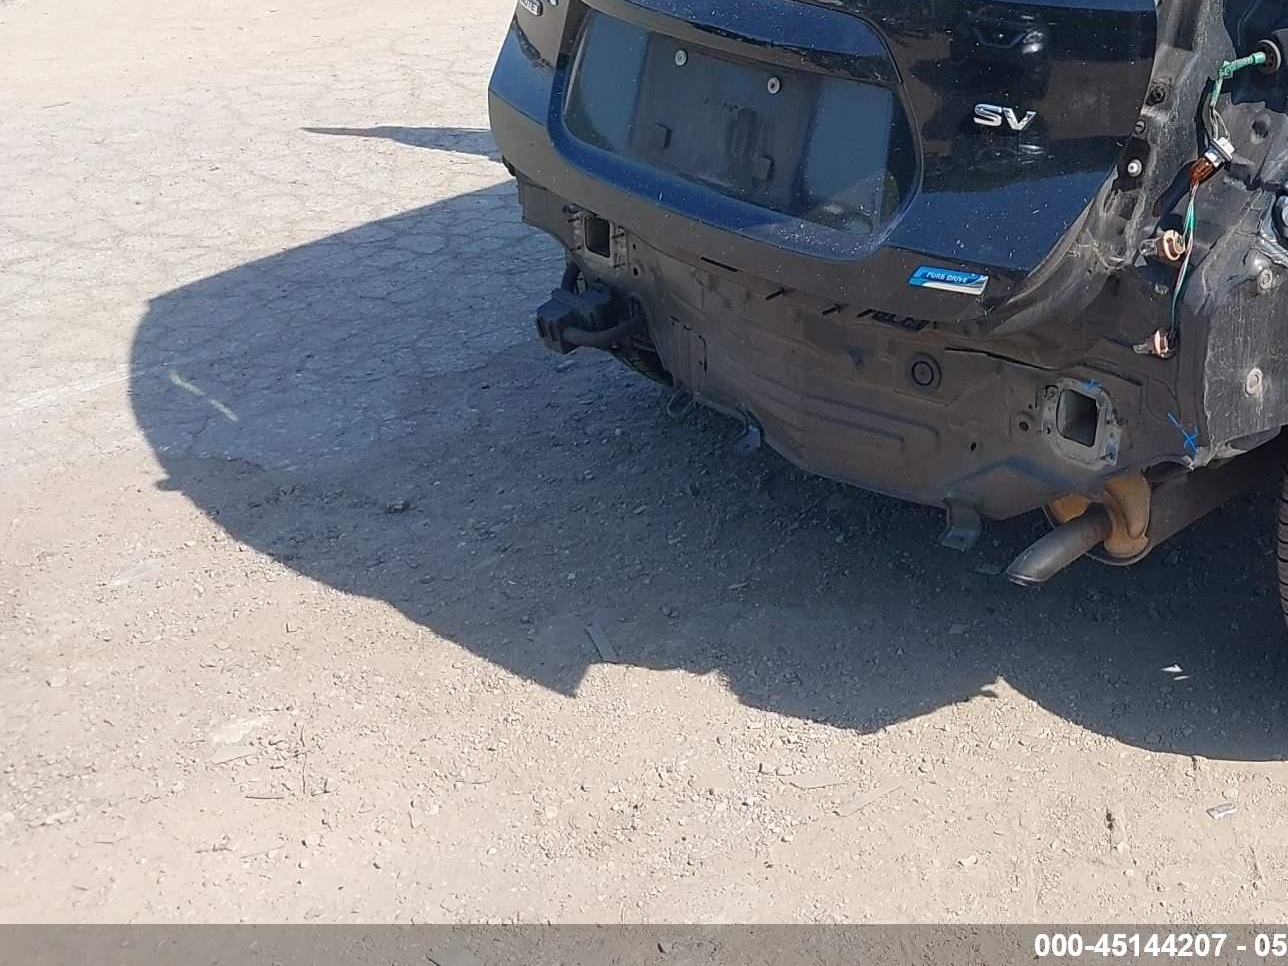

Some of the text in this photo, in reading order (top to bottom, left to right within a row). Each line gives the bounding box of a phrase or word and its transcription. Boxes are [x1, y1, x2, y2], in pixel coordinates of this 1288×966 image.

[973, 103, 1037, 131] SV
[926, 271, 968, 283] PURE DRIVE
